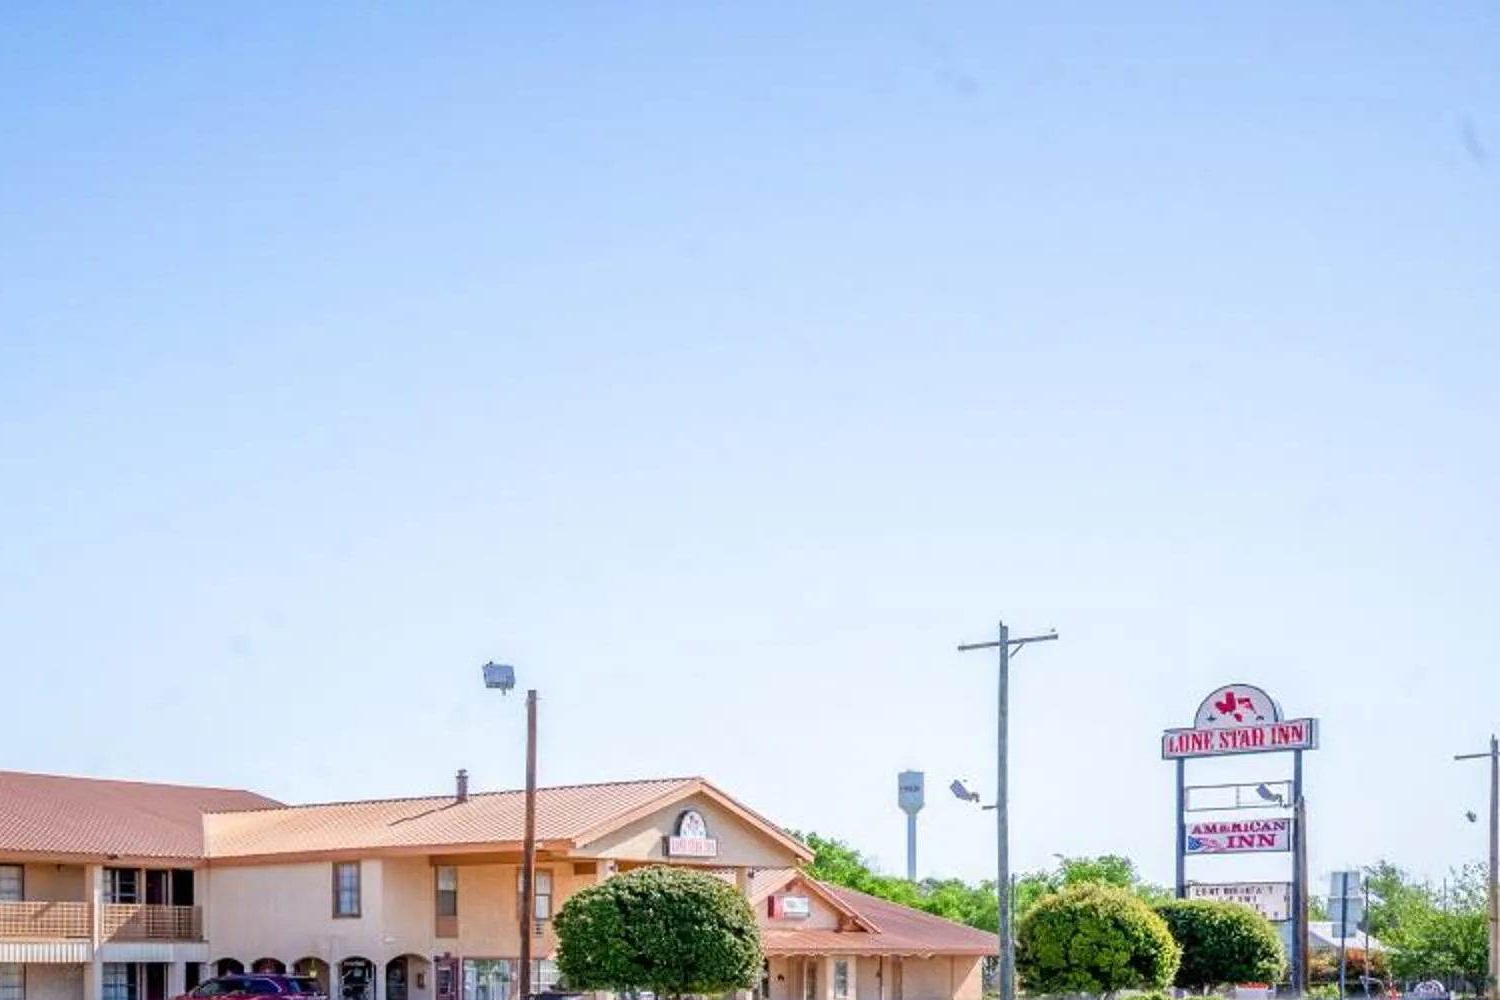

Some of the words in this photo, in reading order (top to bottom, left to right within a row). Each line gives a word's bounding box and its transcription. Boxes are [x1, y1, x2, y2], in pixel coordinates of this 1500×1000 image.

[1169, 731, 1213, 752] LONE
[1219, 727, 1265, 748] STAR
[1271, 723, 1303, 744] INN
[1191, 821, 1286, 834] AMERICAN
[1227, 833, 1276, 848] INN
